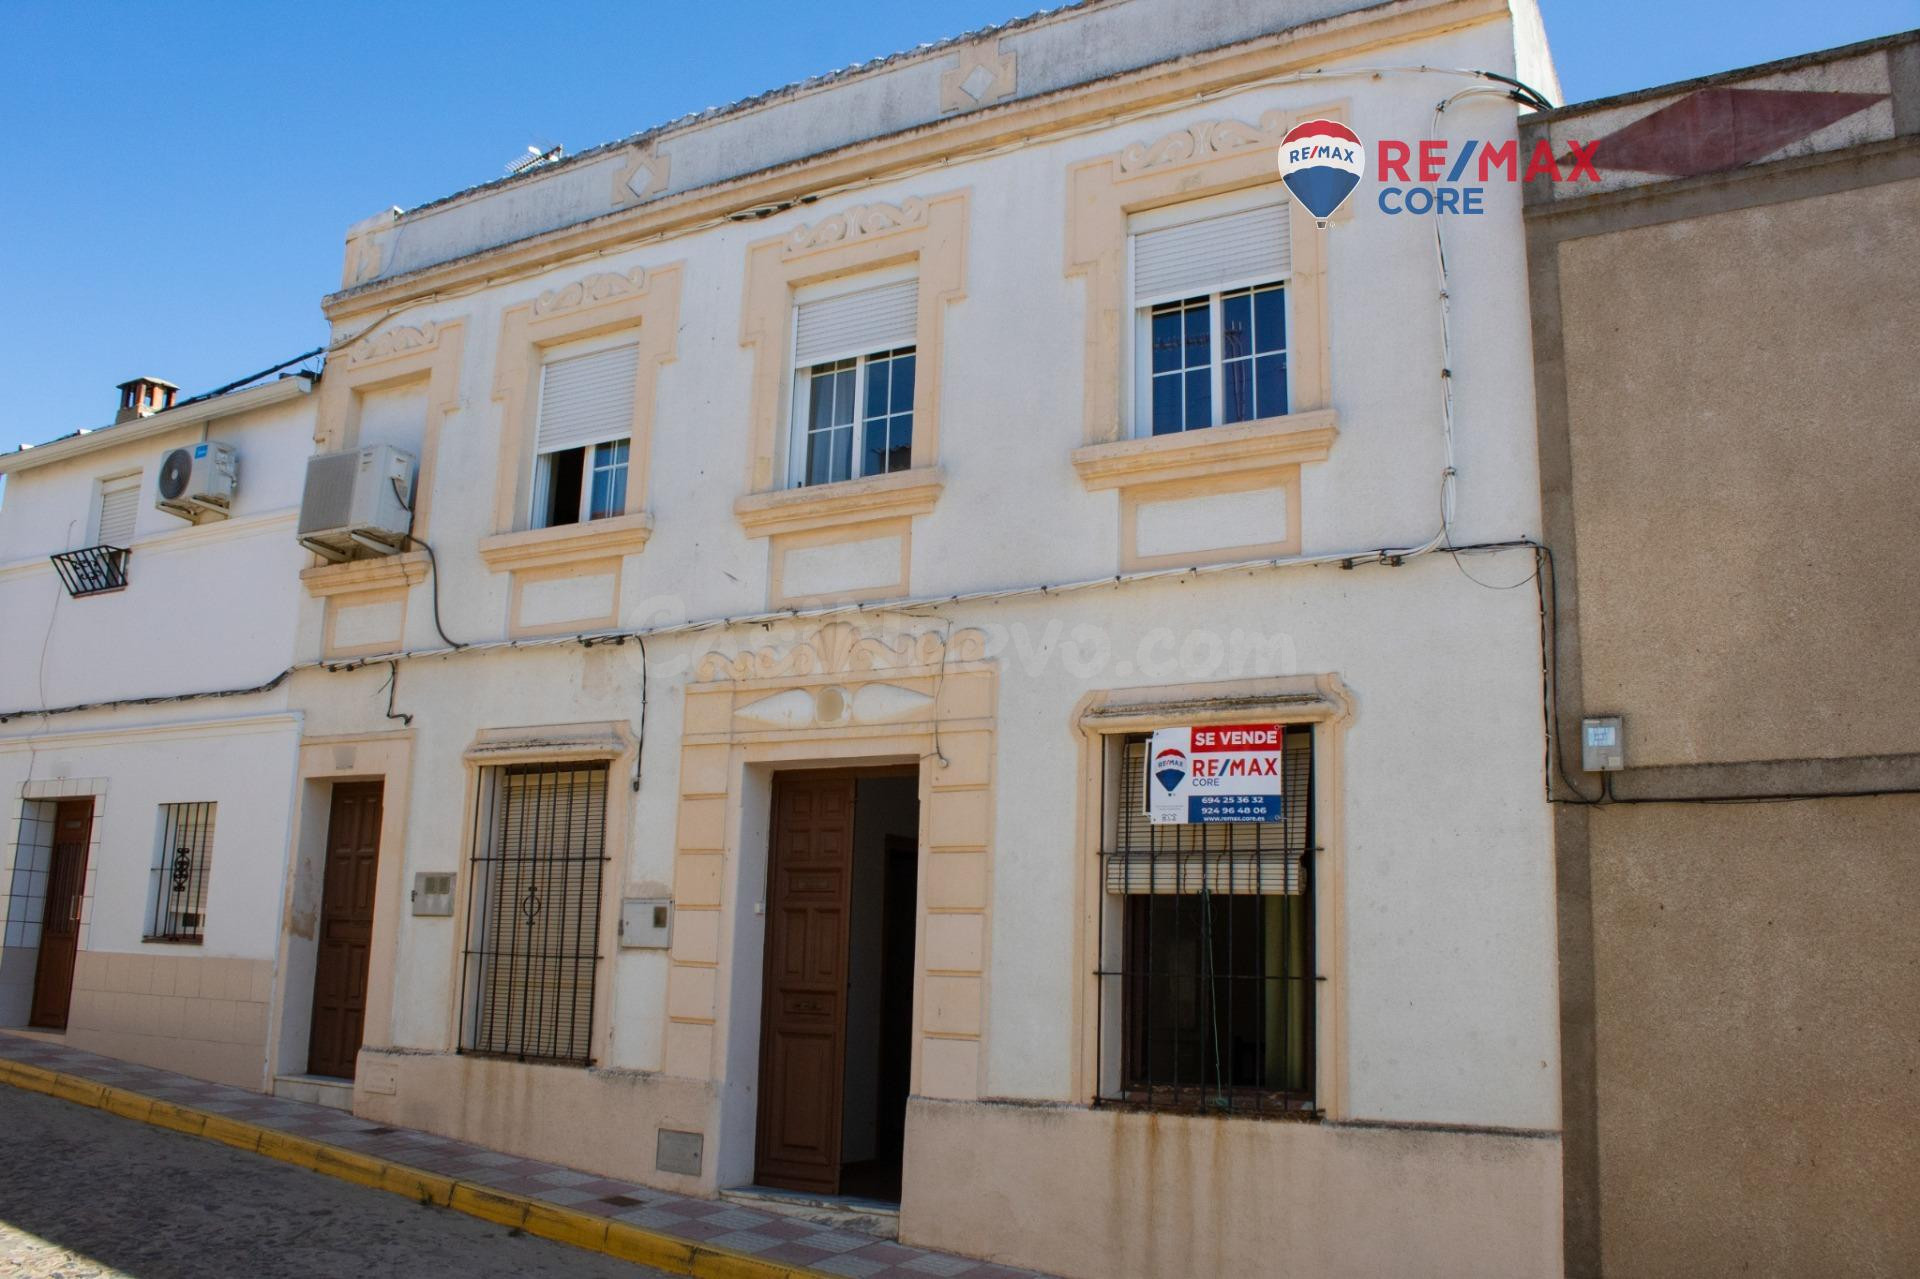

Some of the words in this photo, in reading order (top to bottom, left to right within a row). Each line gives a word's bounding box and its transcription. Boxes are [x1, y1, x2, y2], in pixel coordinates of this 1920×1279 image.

[1195, 732, 1215, 746] SE
[1219, 731, 1278, 745] VENDE
[1158, 759, 1184, 768] RE/MAX
[1192, 758, 1278, 777] RE/MAX
[1192, 778, 1220, 787] CORE
[1201, 796, 1220, 804] 694
